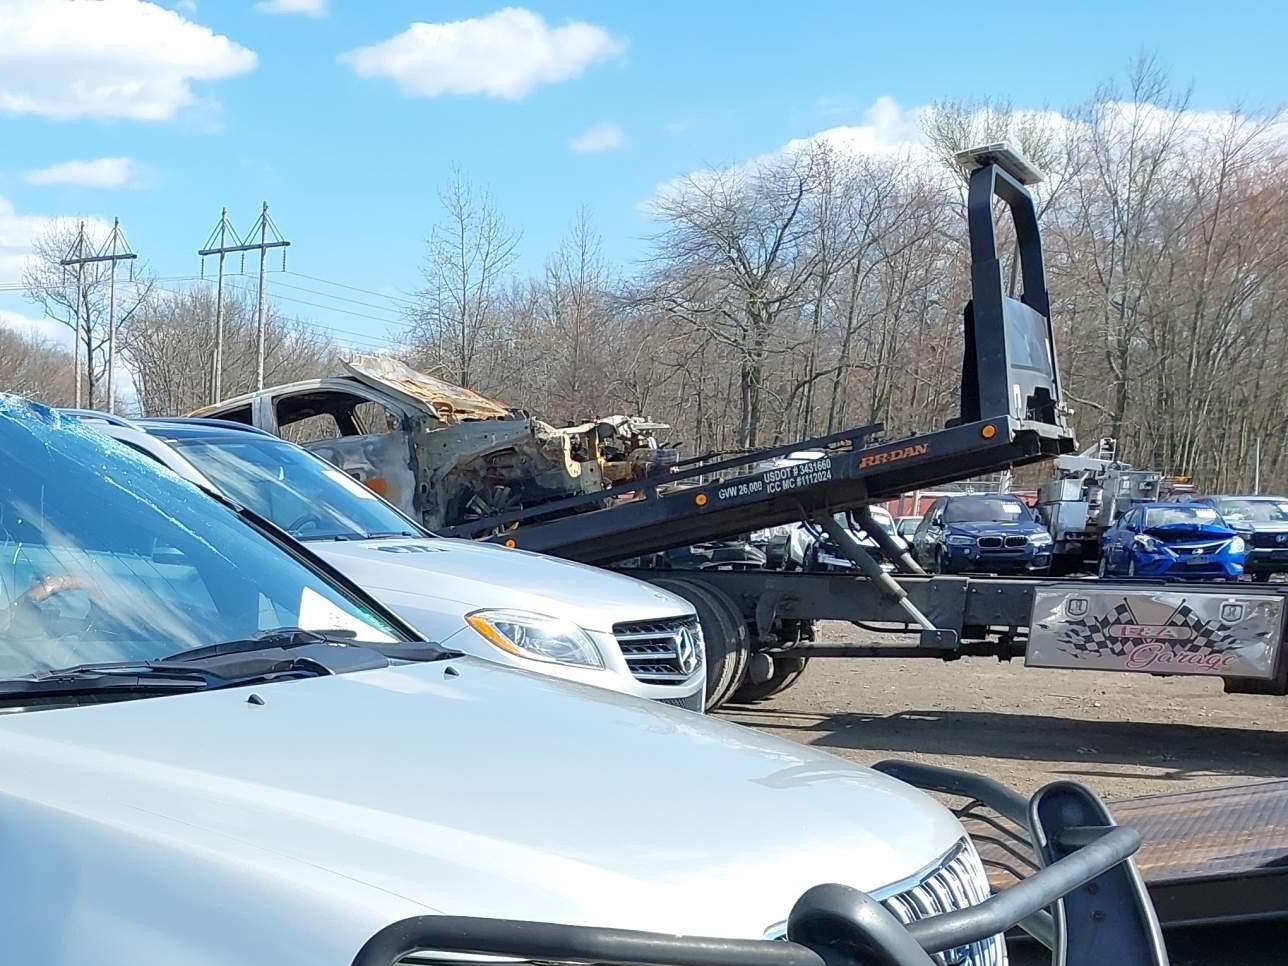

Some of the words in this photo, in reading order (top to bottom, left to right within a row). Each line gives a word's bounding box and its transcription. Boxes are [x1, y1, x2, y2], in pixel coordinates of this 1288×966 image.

[763, 467, 792, 483] USDOT
[718, 486, 737, 500] GVW
[738, 480, 762, 496] 26,000
[767, 481, 781, 494] ICC
[782, 478, 796, 490] MC
[1126, 642, 1236, 671] Garage
